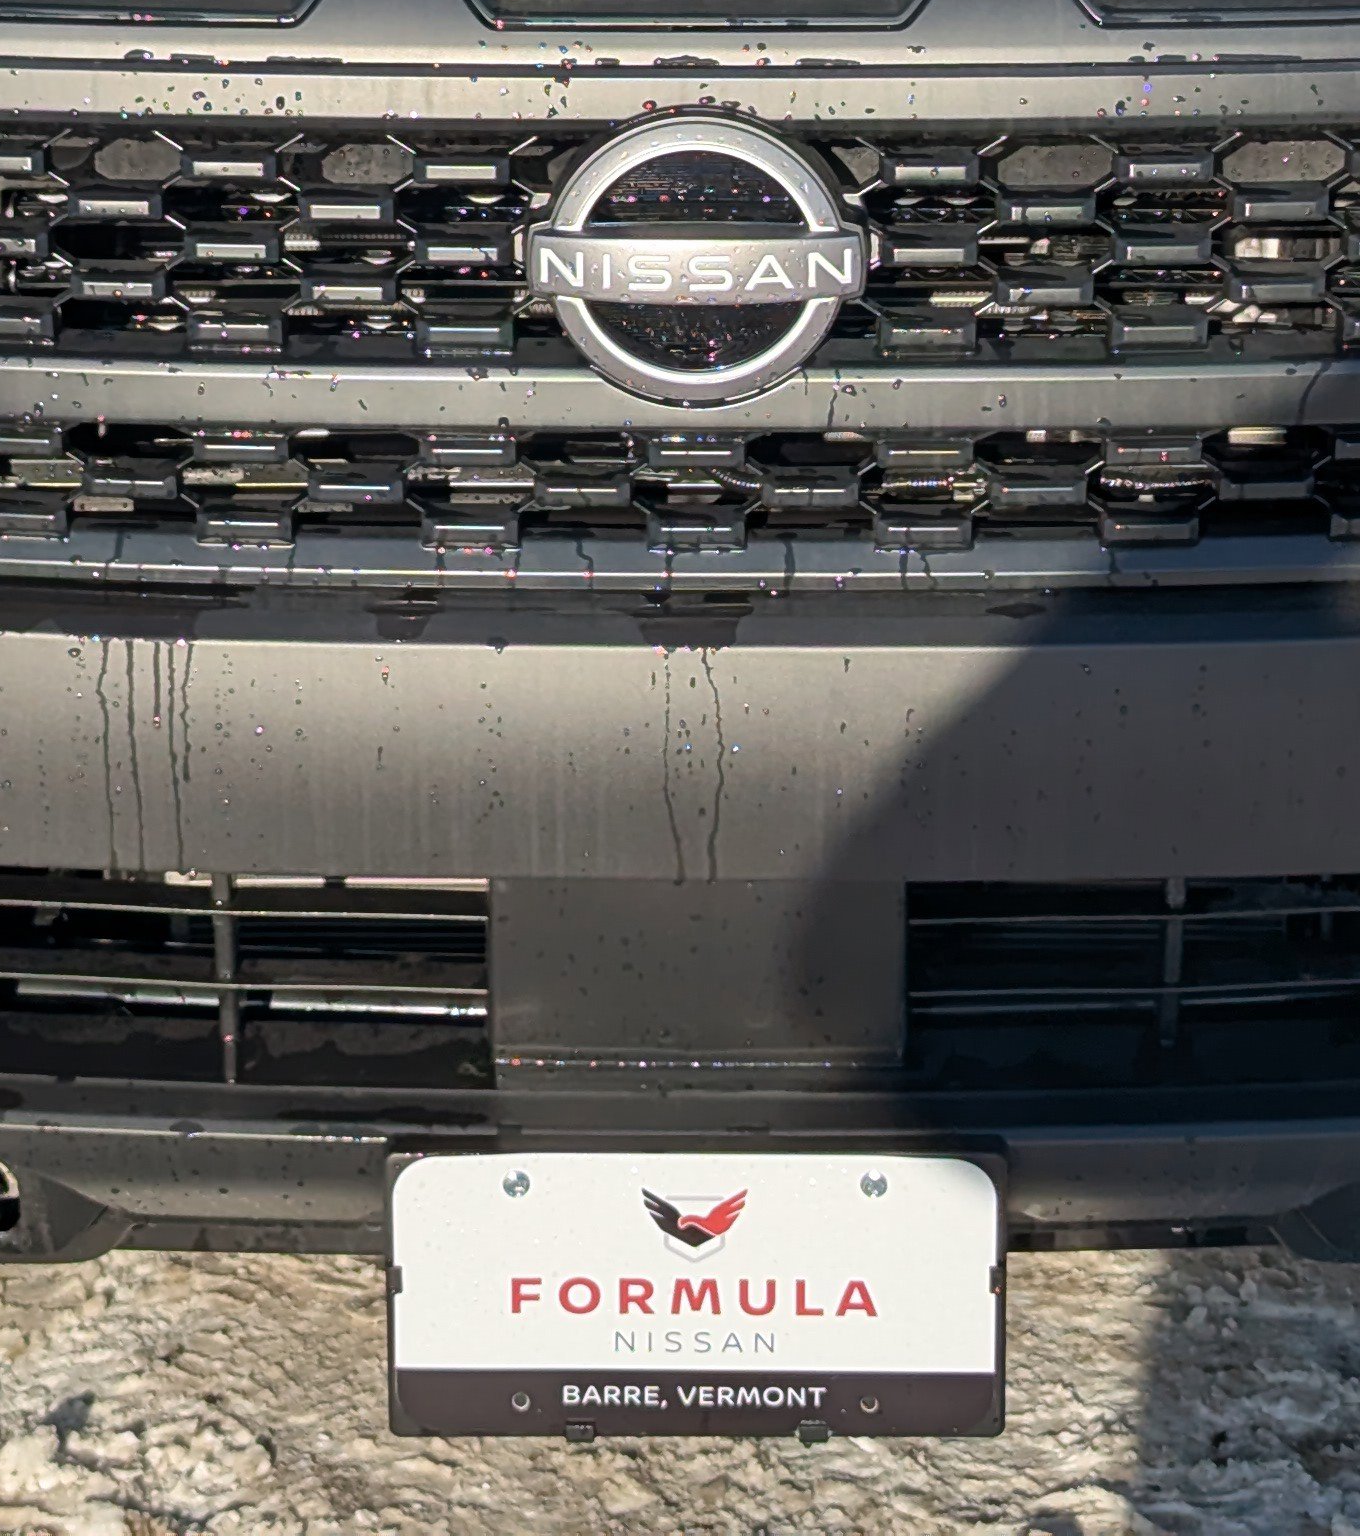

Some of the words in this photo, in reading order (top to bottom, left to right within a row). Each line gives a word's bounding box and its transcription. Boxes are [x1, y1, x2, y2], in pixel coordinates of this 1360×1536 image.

[539, 247, 853, 293] NISSAN
[510, 1276, 879, 1317] FORMULA
[614, 1330, 776, 1354] NISSAN
[562, 1384, 668, 1409] BARRE,
[677, 1385, 828, 1408] VERMONT
